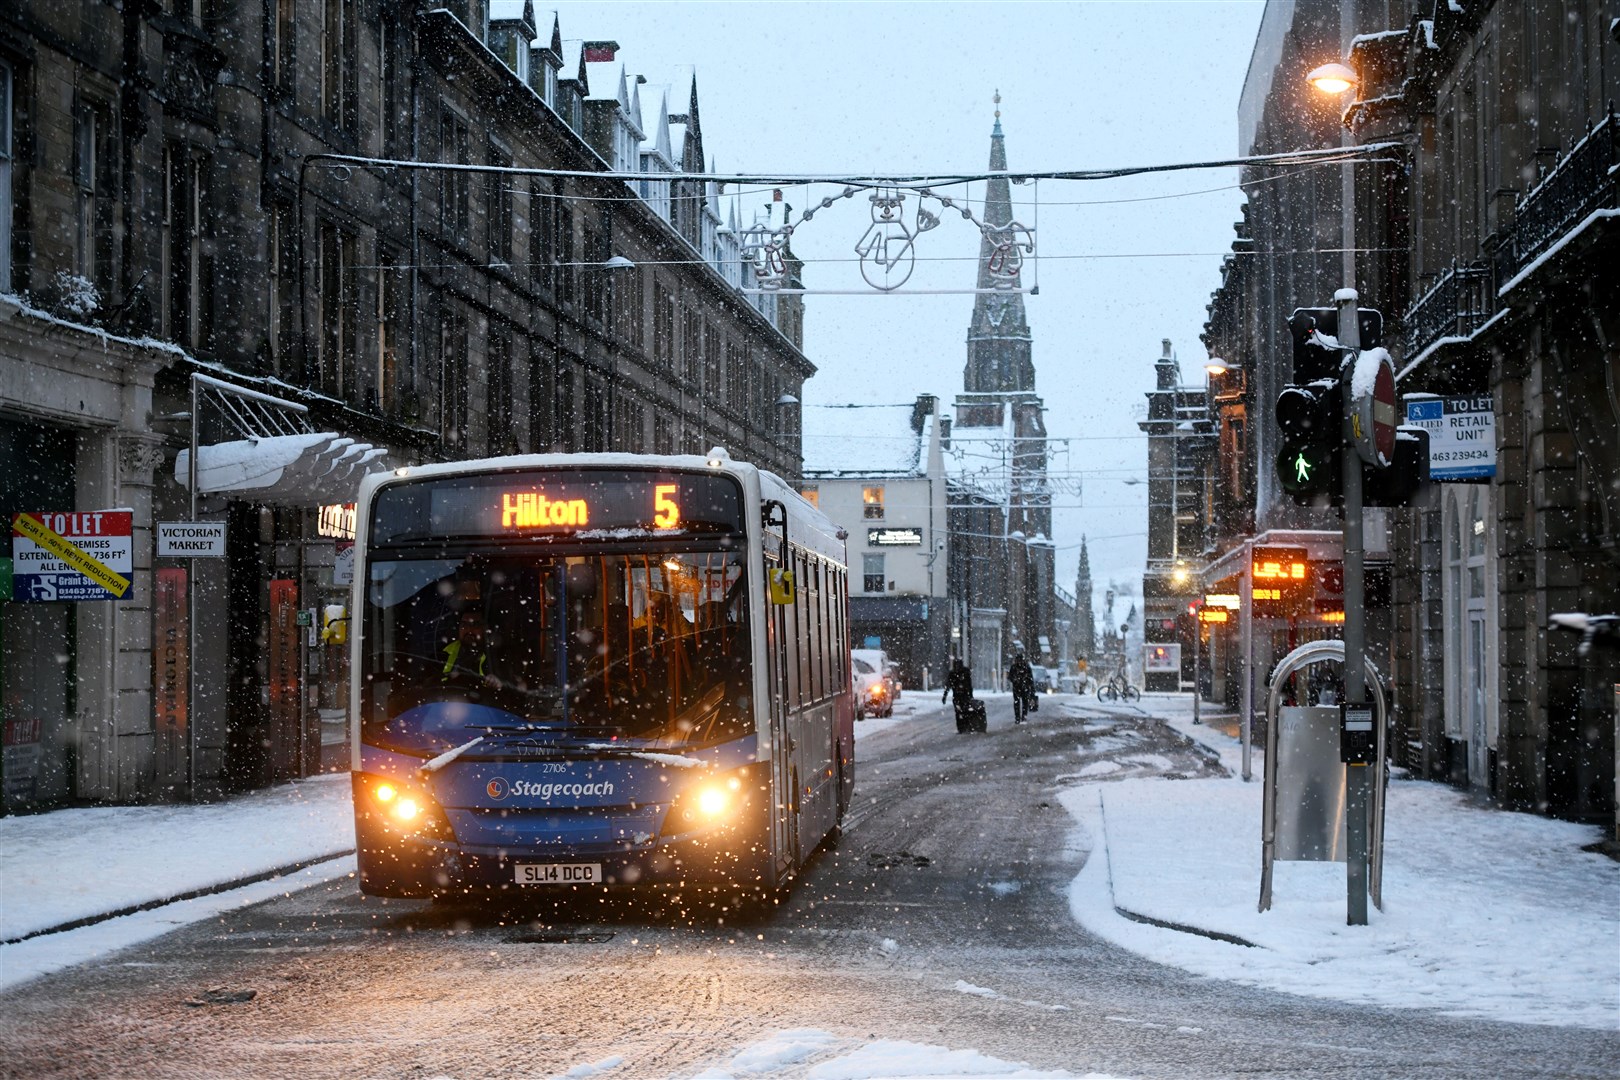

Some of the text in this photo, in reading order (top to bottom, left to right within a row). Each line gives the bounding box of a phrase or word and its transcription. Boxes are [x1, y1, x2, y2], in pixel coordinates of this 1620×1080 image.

[1451, 398, 1493, 412] TO LET
[1450, 416, 1492, 428] RETAIL
[1456, 429, 1486, 441] UNIT
[1452, 450, 1489, 461] 239434
[502, 492, 588, 529] Hilton
[653, 484, 680, 529] 5
[41, 513, 103, 535] TO LET
[162, 528, 222, 538] VICTORIAN
[168, 541, 215, 550] MARKET
[20, 518, 39, 536] YEAR
[63, 548, 84, 565] RENT
[83, 561, 125, 591] REDUCTION
[40, 563, 57, 571] ALL
[58, 576, 82, 586] Grant
[543, 763, 567, 775] 27106
[513, 780, 614, 800] Stagecoach
[524, 866, 593, 881] SL14 DCO
